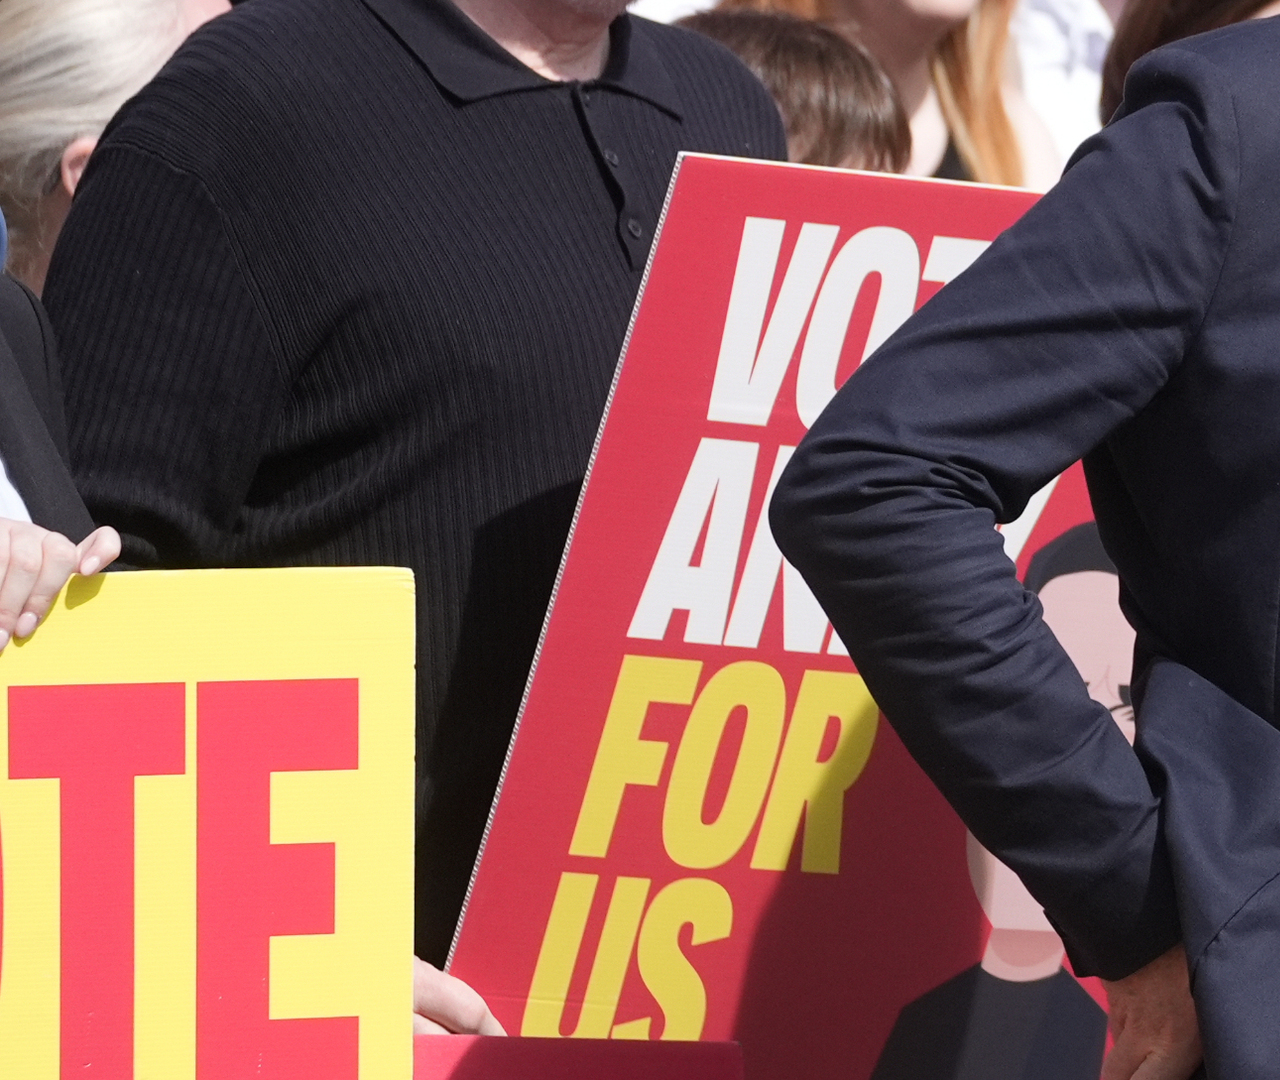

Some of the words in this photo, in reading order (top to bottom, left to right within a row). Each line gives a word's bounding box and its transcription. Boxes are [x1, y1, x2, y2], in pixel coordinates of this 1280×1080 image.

[706, 215, 992, 433] VO
[568, 652, 880, 875] FOR
[520, 869, 733, 1042] US
